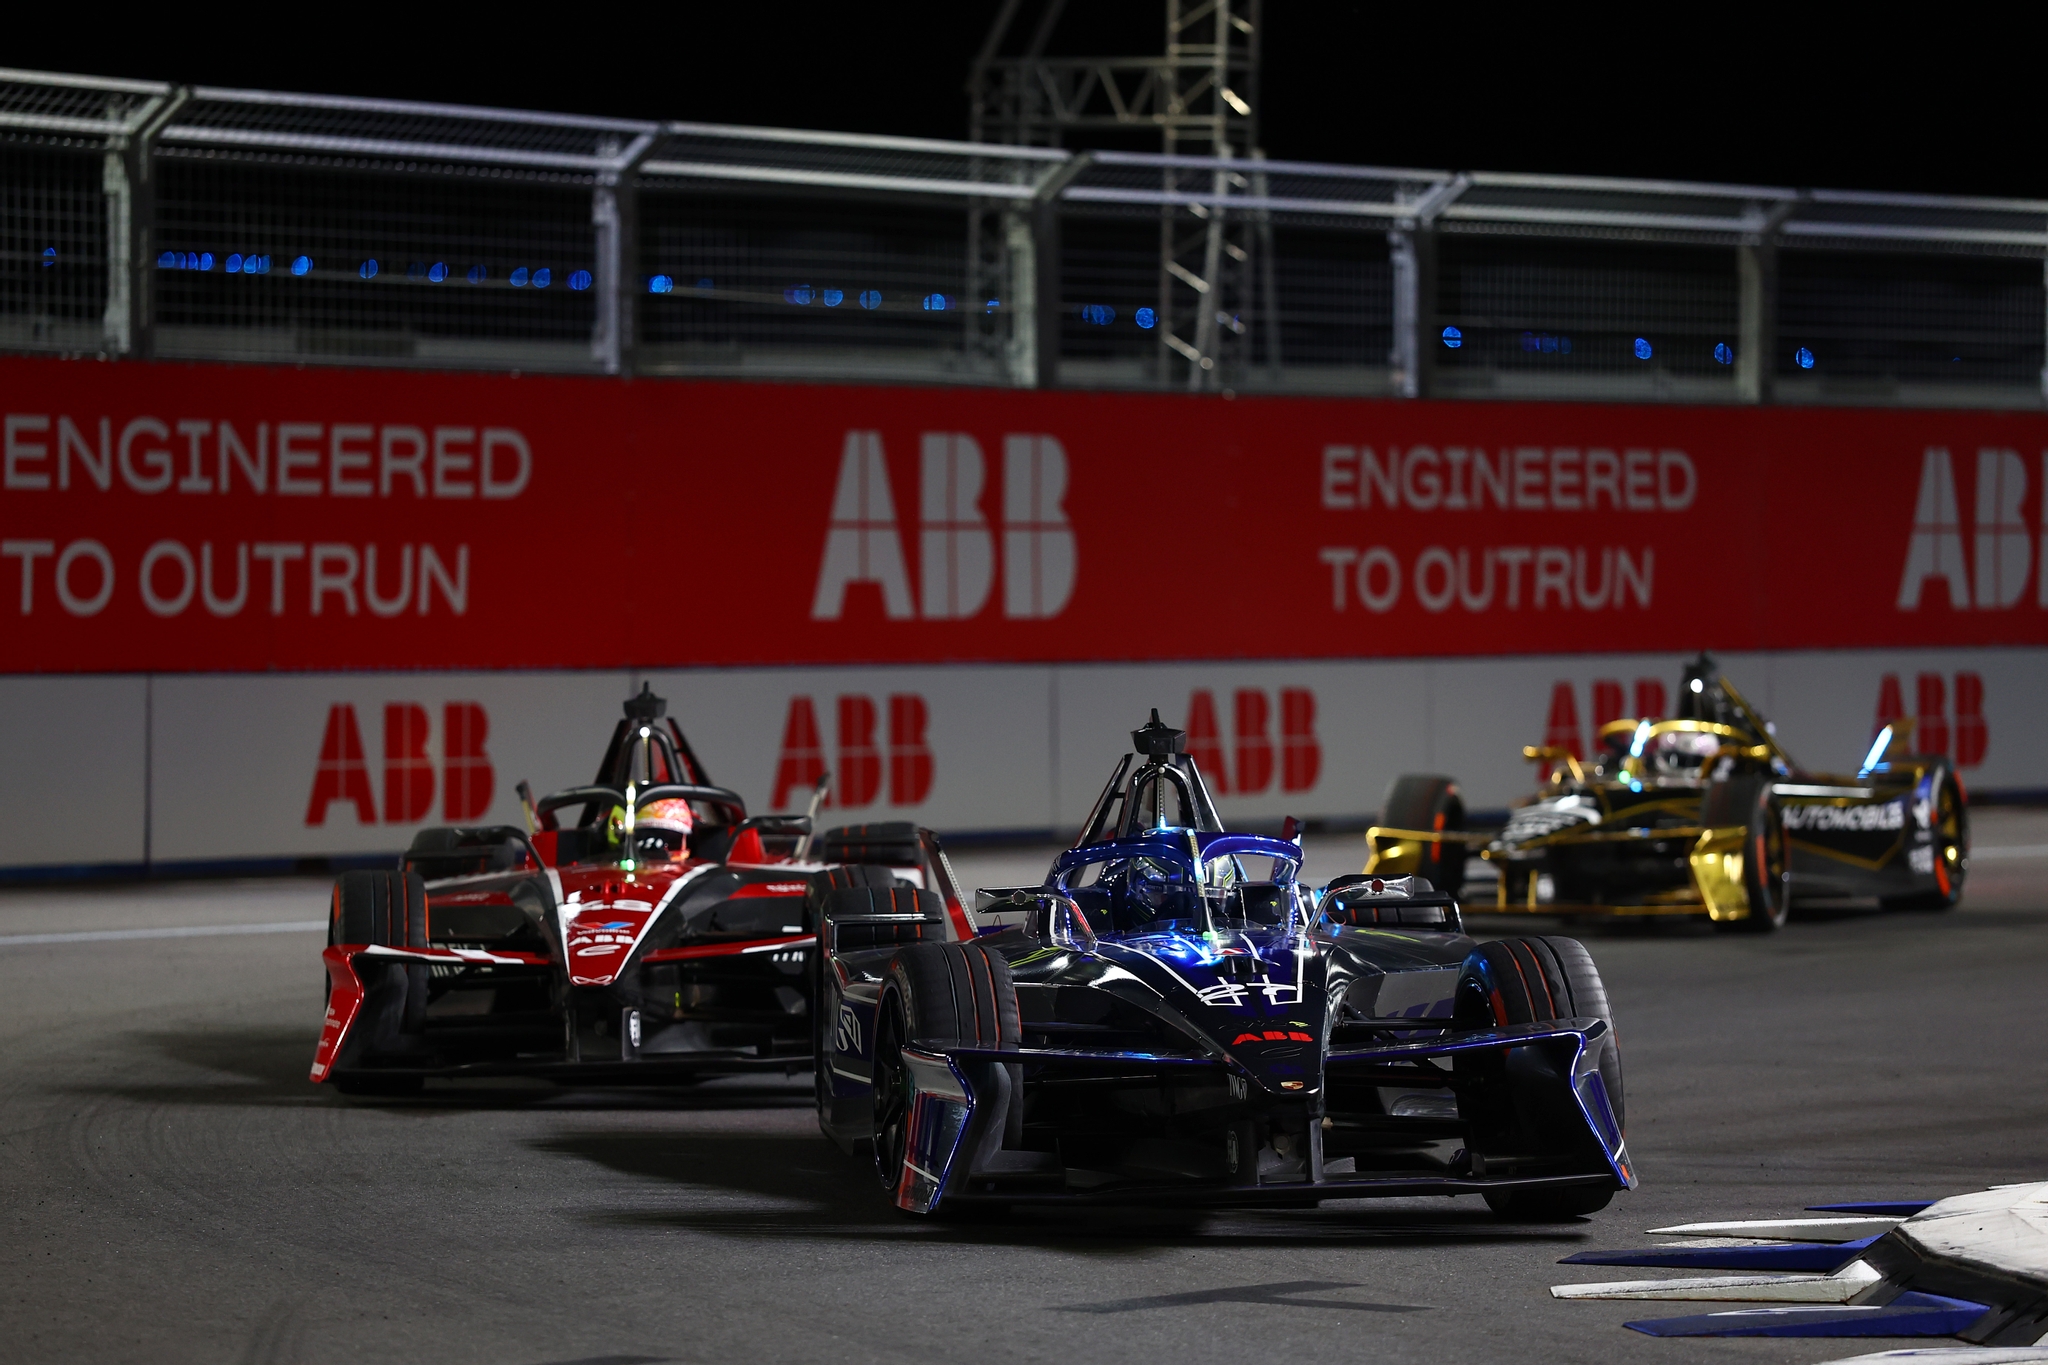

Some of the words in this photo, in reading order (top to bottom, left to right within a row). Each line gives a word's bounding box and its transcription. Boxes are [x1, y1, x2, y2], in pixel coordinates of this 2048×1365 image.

[3, 414, 532, 499] ENGINEERED
[1321, 444, 1697, 511] ENGINEERED
[810, 429, 1078, 622] ABB
[1896, 446, 2048, 611] AB
[0, 538, 116, 617] TO
[138, 538, 470, 618] OUTRUN
[1319, 546, 1402, 613] TO
[1413, 546, 1654, 613] OUTRUN
[305, 702, 495, 827] ABB
[770, 694, 935, 810] ABB
[1182, 687, 1322, 796] ABB
[1231, 1030, 1314, 1046] ABB
